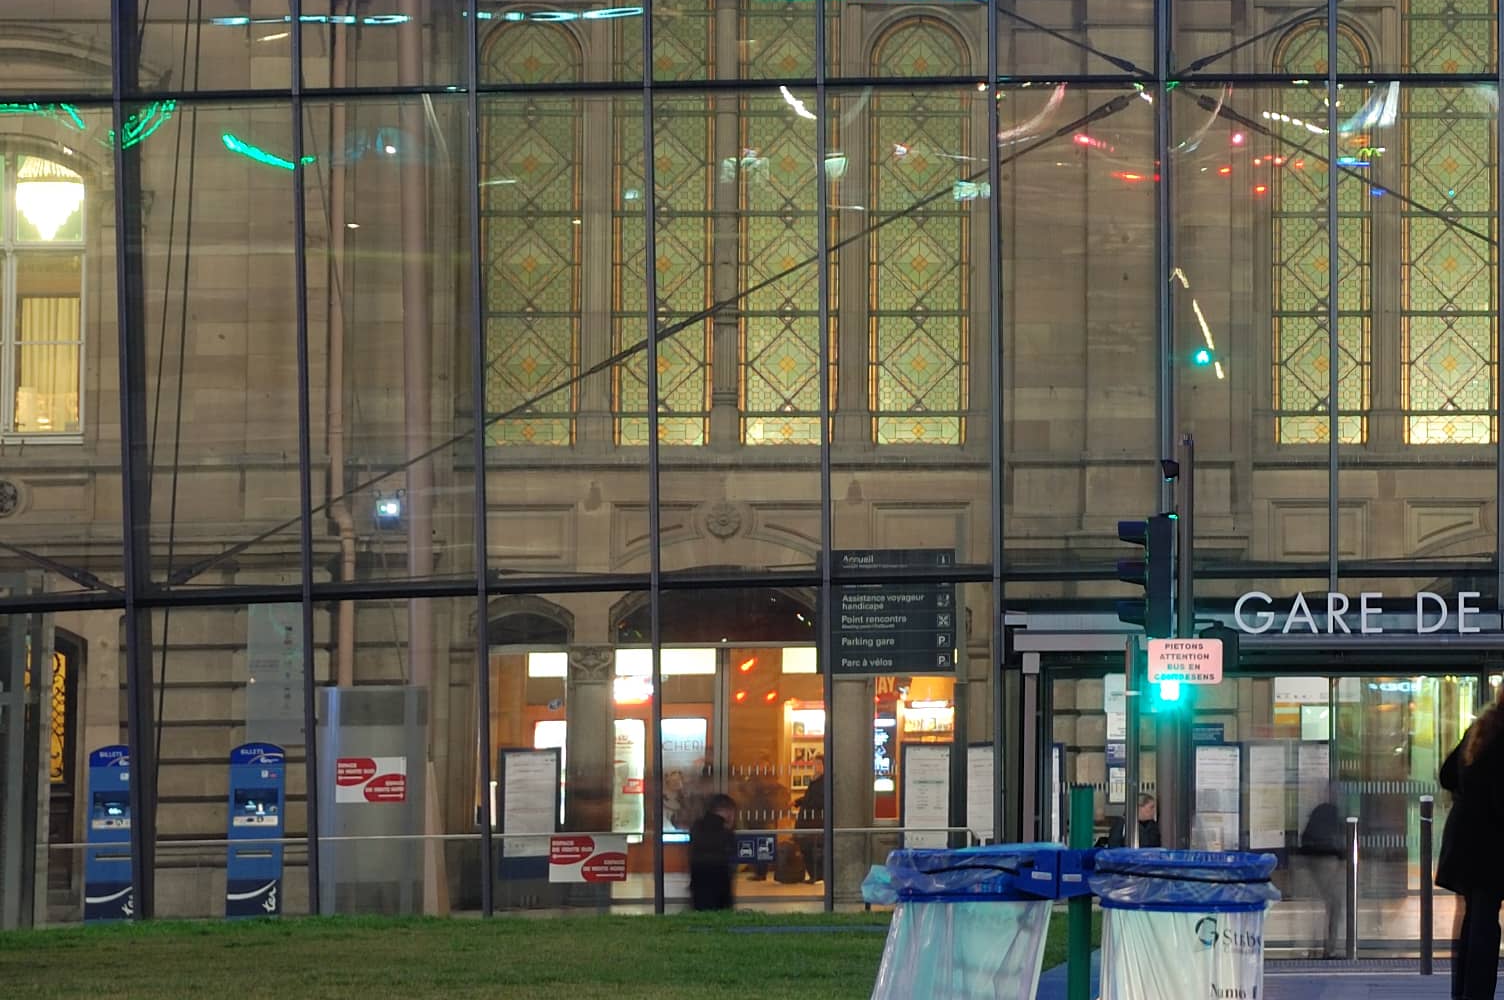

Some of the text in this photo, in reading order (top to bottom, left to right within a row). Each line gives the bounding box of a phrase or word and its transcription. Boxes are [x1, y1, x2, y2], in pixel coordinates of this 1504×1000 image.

[842, 555, 874, 564] Accueil
[886, 594, 924, 602] voyageur
[1234, 591, 1383, 634] GARE
[1416, 592, 1480, 633] DE
[842, 615, 864, 624] Point
[842, 638, 874, 647] Parking
[875, 638, 895, 648] gare
[842, 658, 860, 667] Parc
